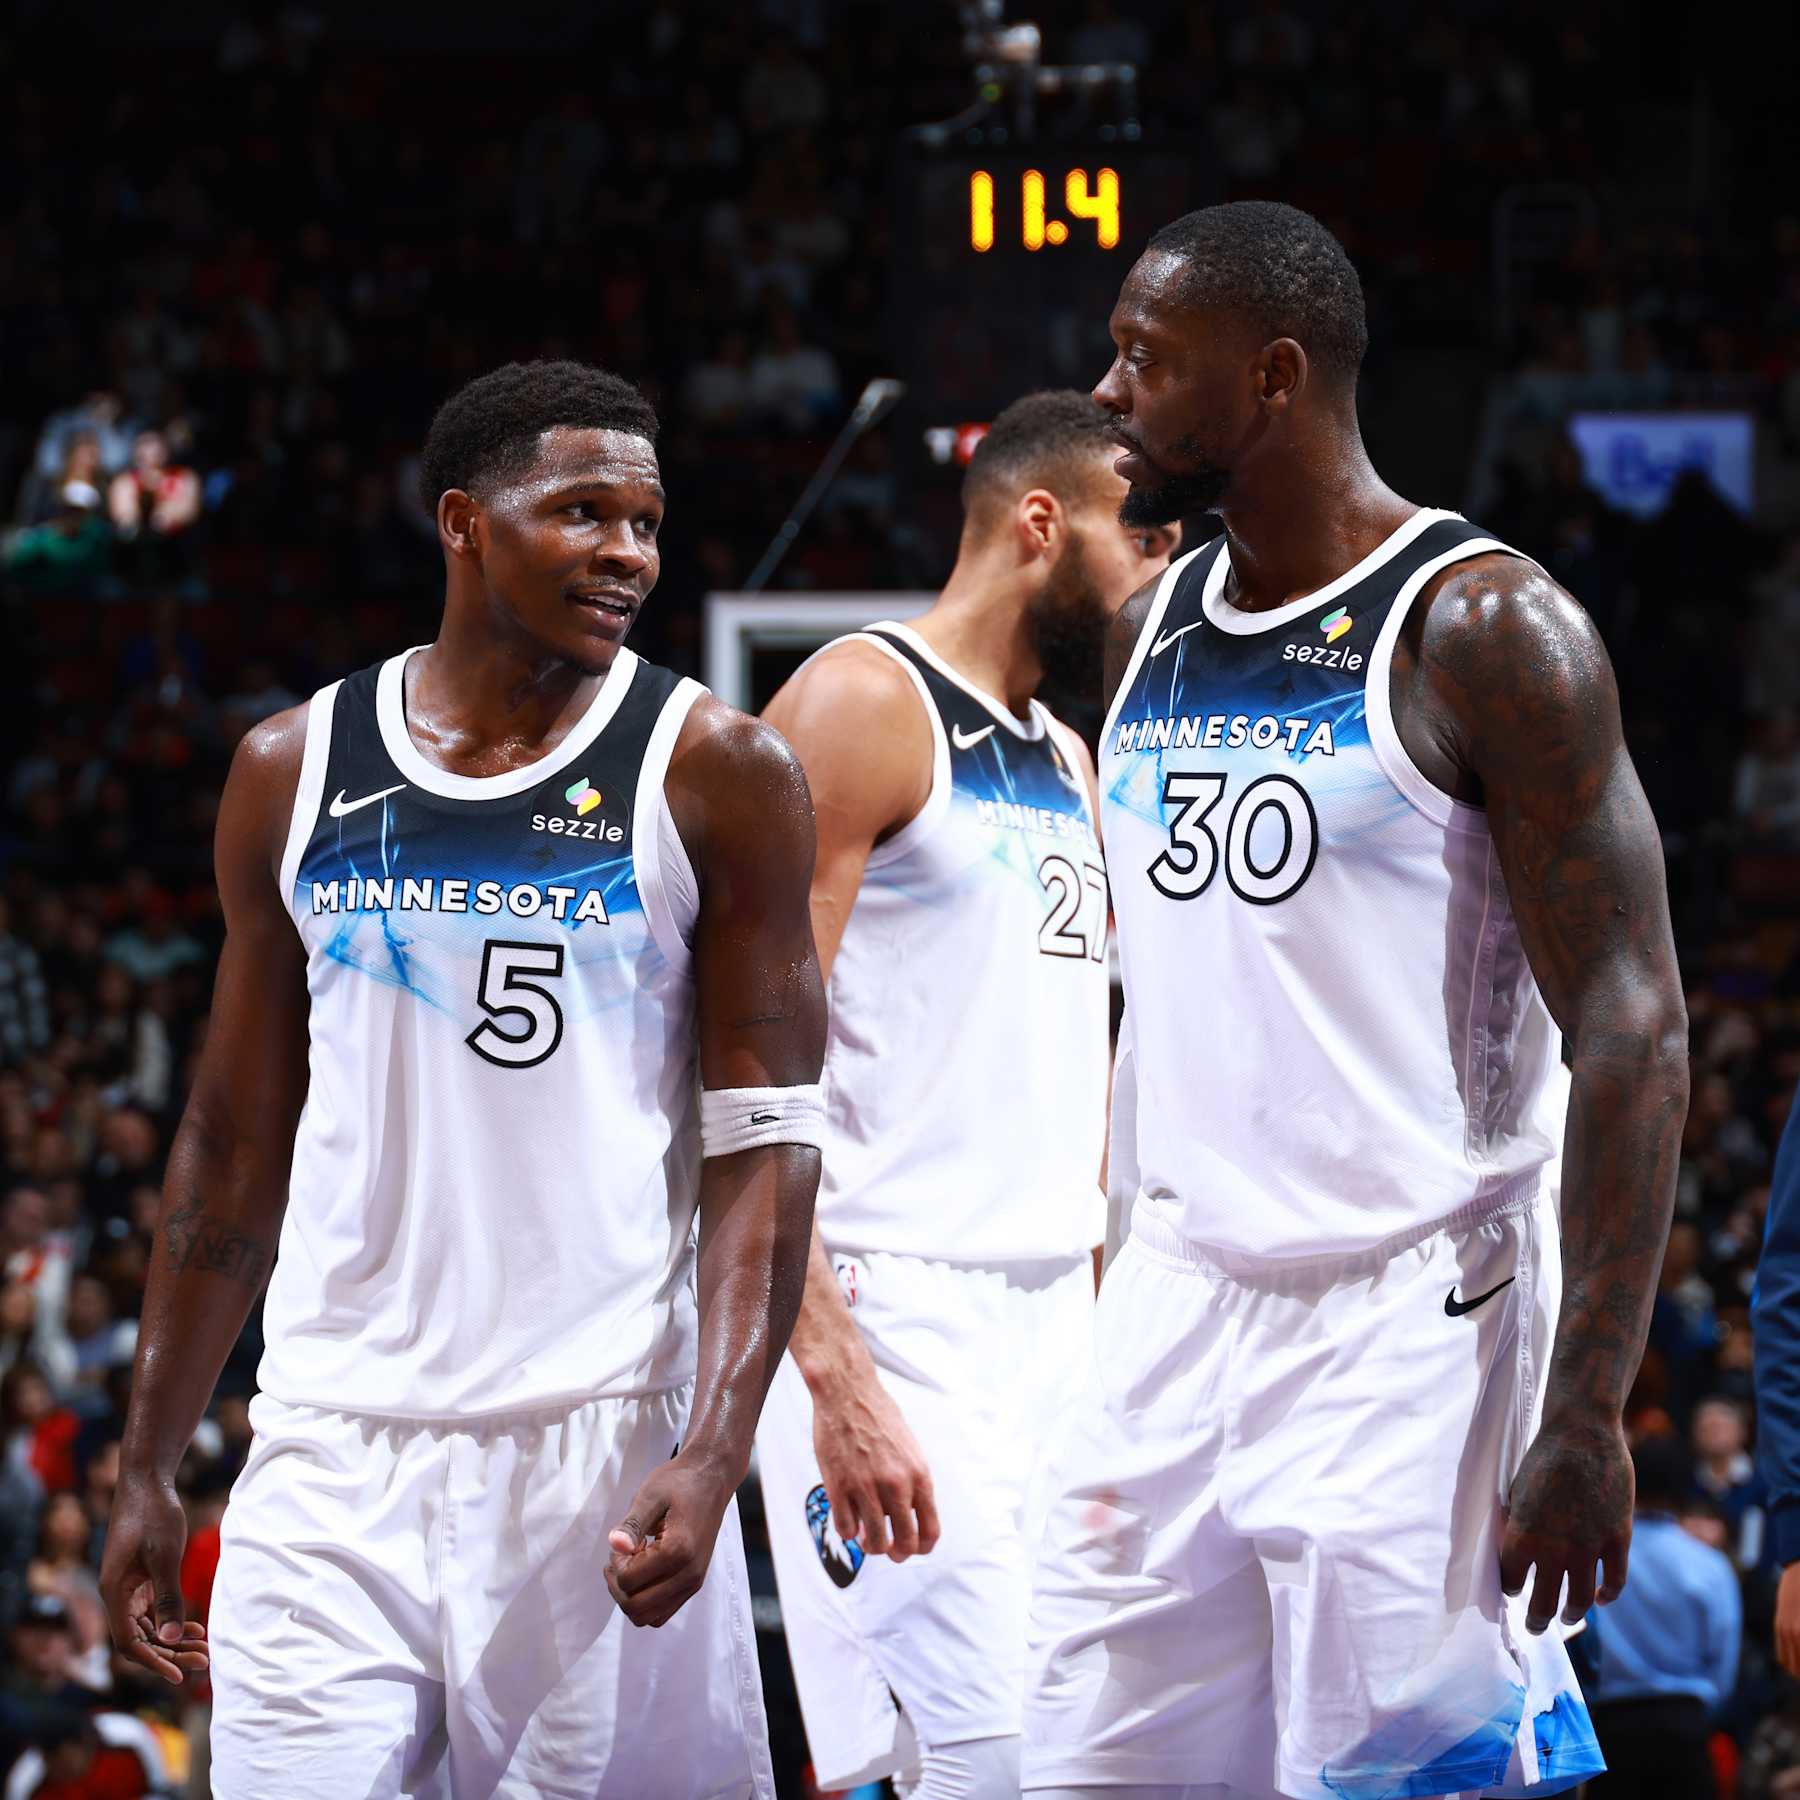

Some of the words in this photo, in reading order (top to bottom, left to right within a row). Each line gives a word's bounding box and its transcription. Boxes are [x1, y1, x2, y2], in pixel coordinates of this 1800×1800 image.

[971, 168, 1119, 251] 11.4
[1282, 643, 1363, 671] sezzle
[1115, 715, 1335, 756] MINNESOTA
[531, 813, 624, 842] sezzle
[1147, 772, 1318, 905] 30
[311, 878, 610, 925] MINNESOTA
[465, 939, 565, 1069] 5
